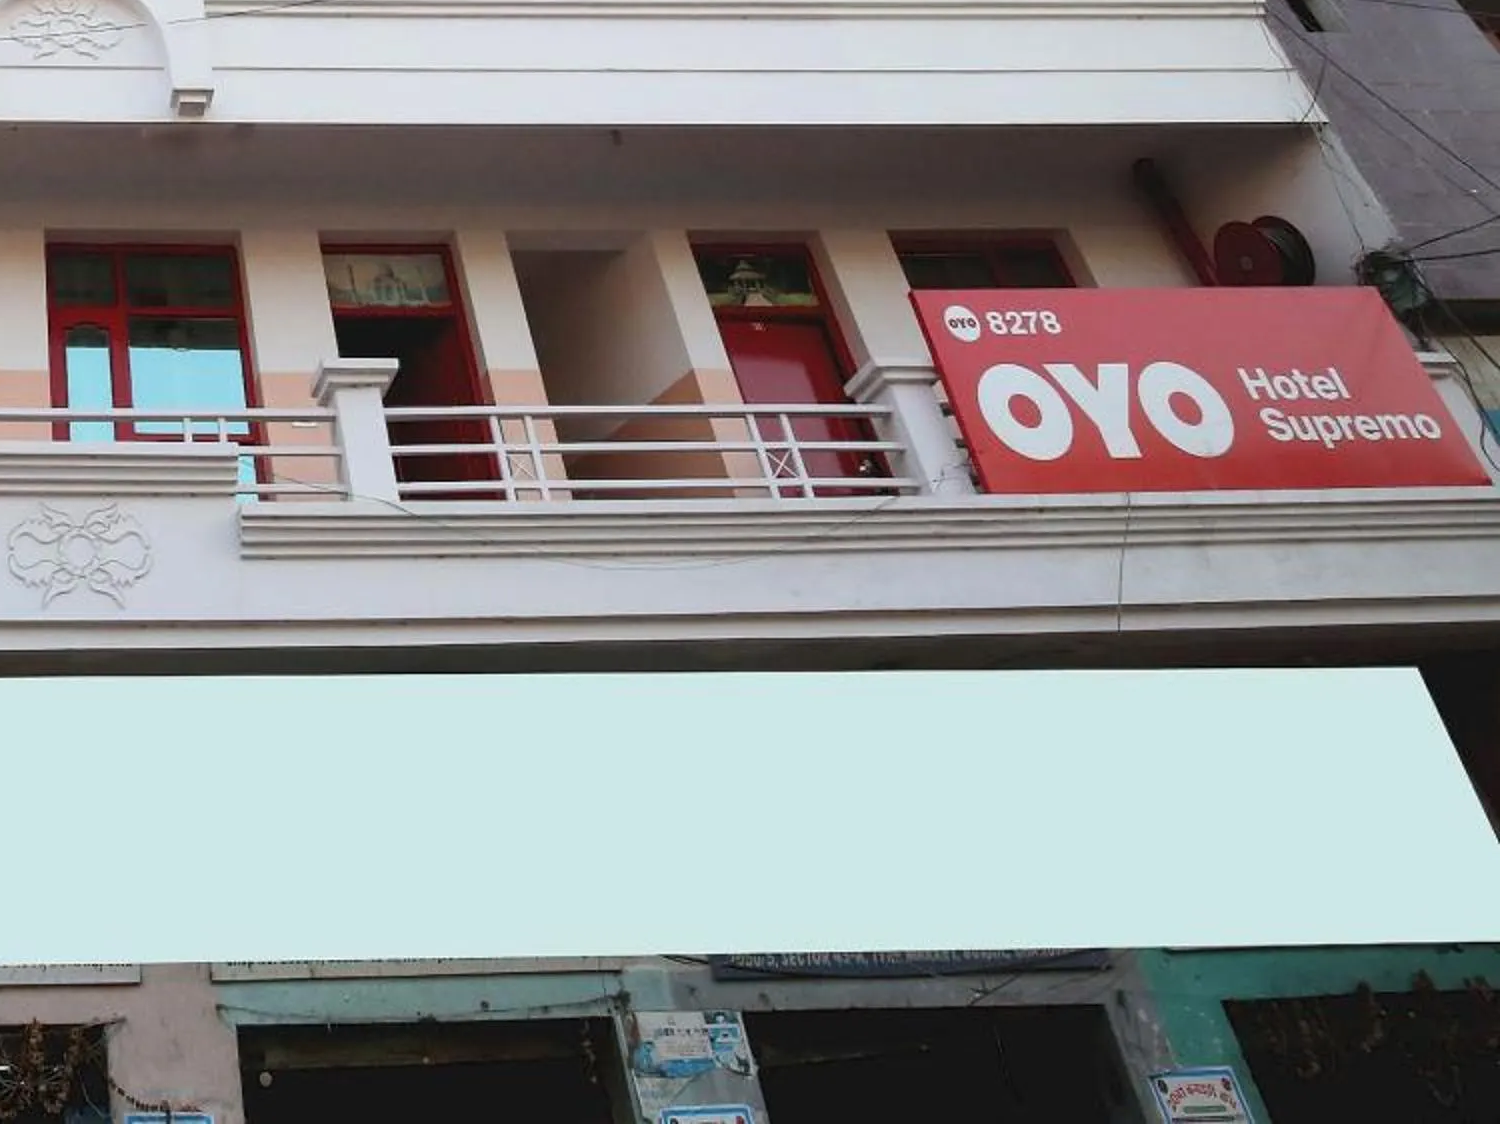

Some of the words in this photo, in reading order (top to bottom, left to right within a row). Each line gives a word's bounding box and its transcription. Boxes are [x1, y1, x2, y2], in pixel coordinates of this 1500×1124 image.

[948, 317, 977, 329] OYO
[985, 311, 1062, 335] 8278
[1236, 367, 1351, 401] Hotel
[977, 362, 1235, 461] OYO
[1259, 407, 1442, 449] Supremo
